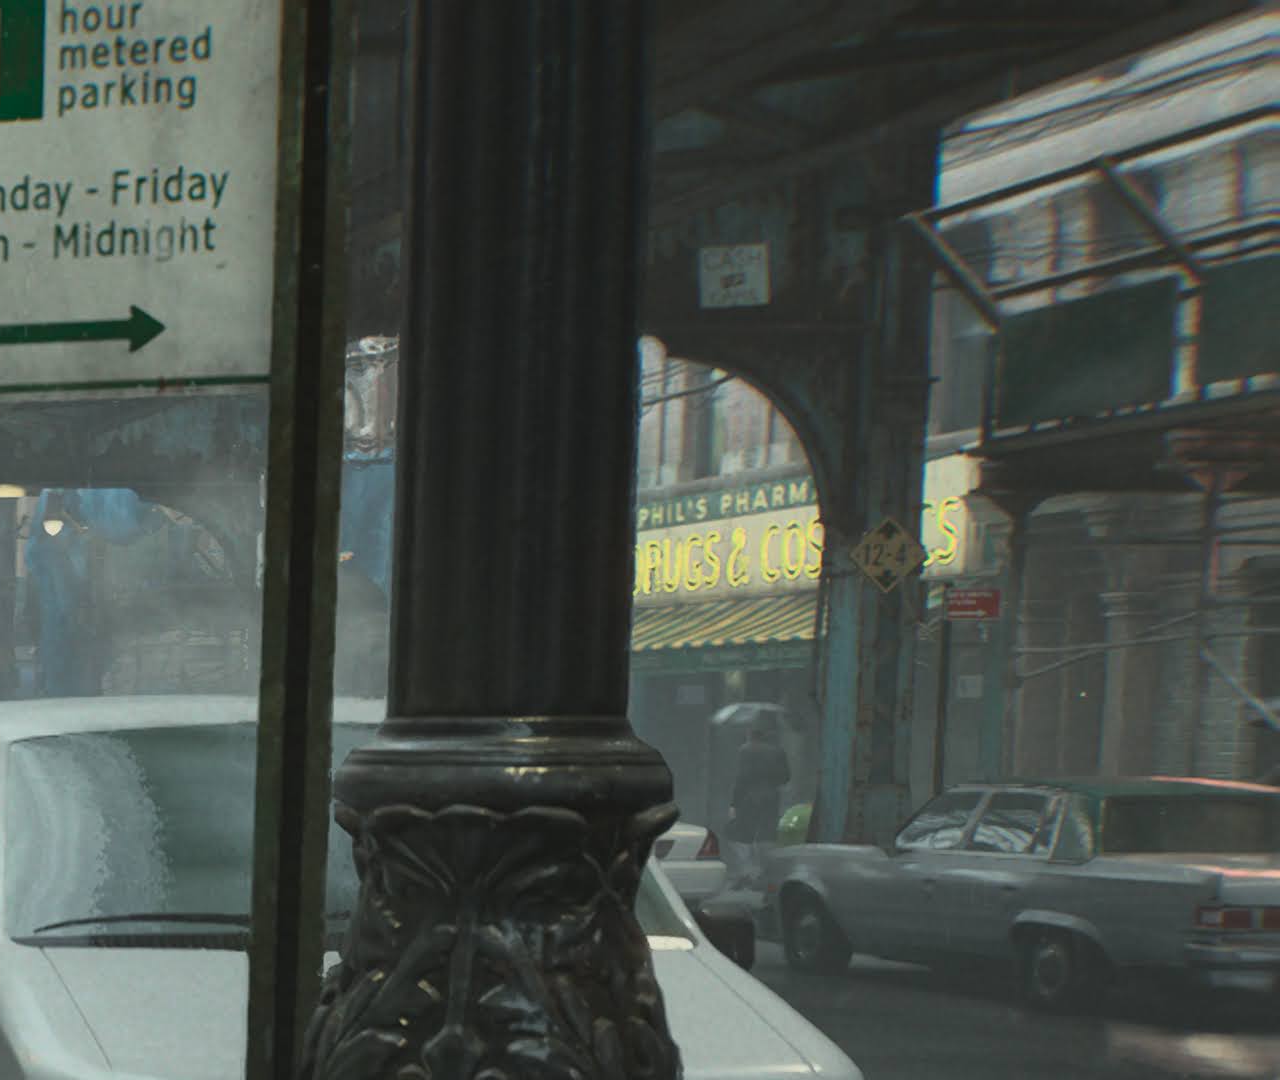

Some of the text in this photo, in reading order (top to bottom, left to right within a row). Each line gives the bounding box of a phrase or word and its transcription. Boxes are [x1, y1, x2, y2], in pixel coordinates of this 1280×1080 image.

[60, 0, 143, 35] hour
[58, 24, 212, 71] metered
[57, 69, 197, 117] parking
[112, 164, 230, 209] Friday
[53, 216, 217, 262] Midnight
[637, 479, 817, 529] PHIL'S PHARM
